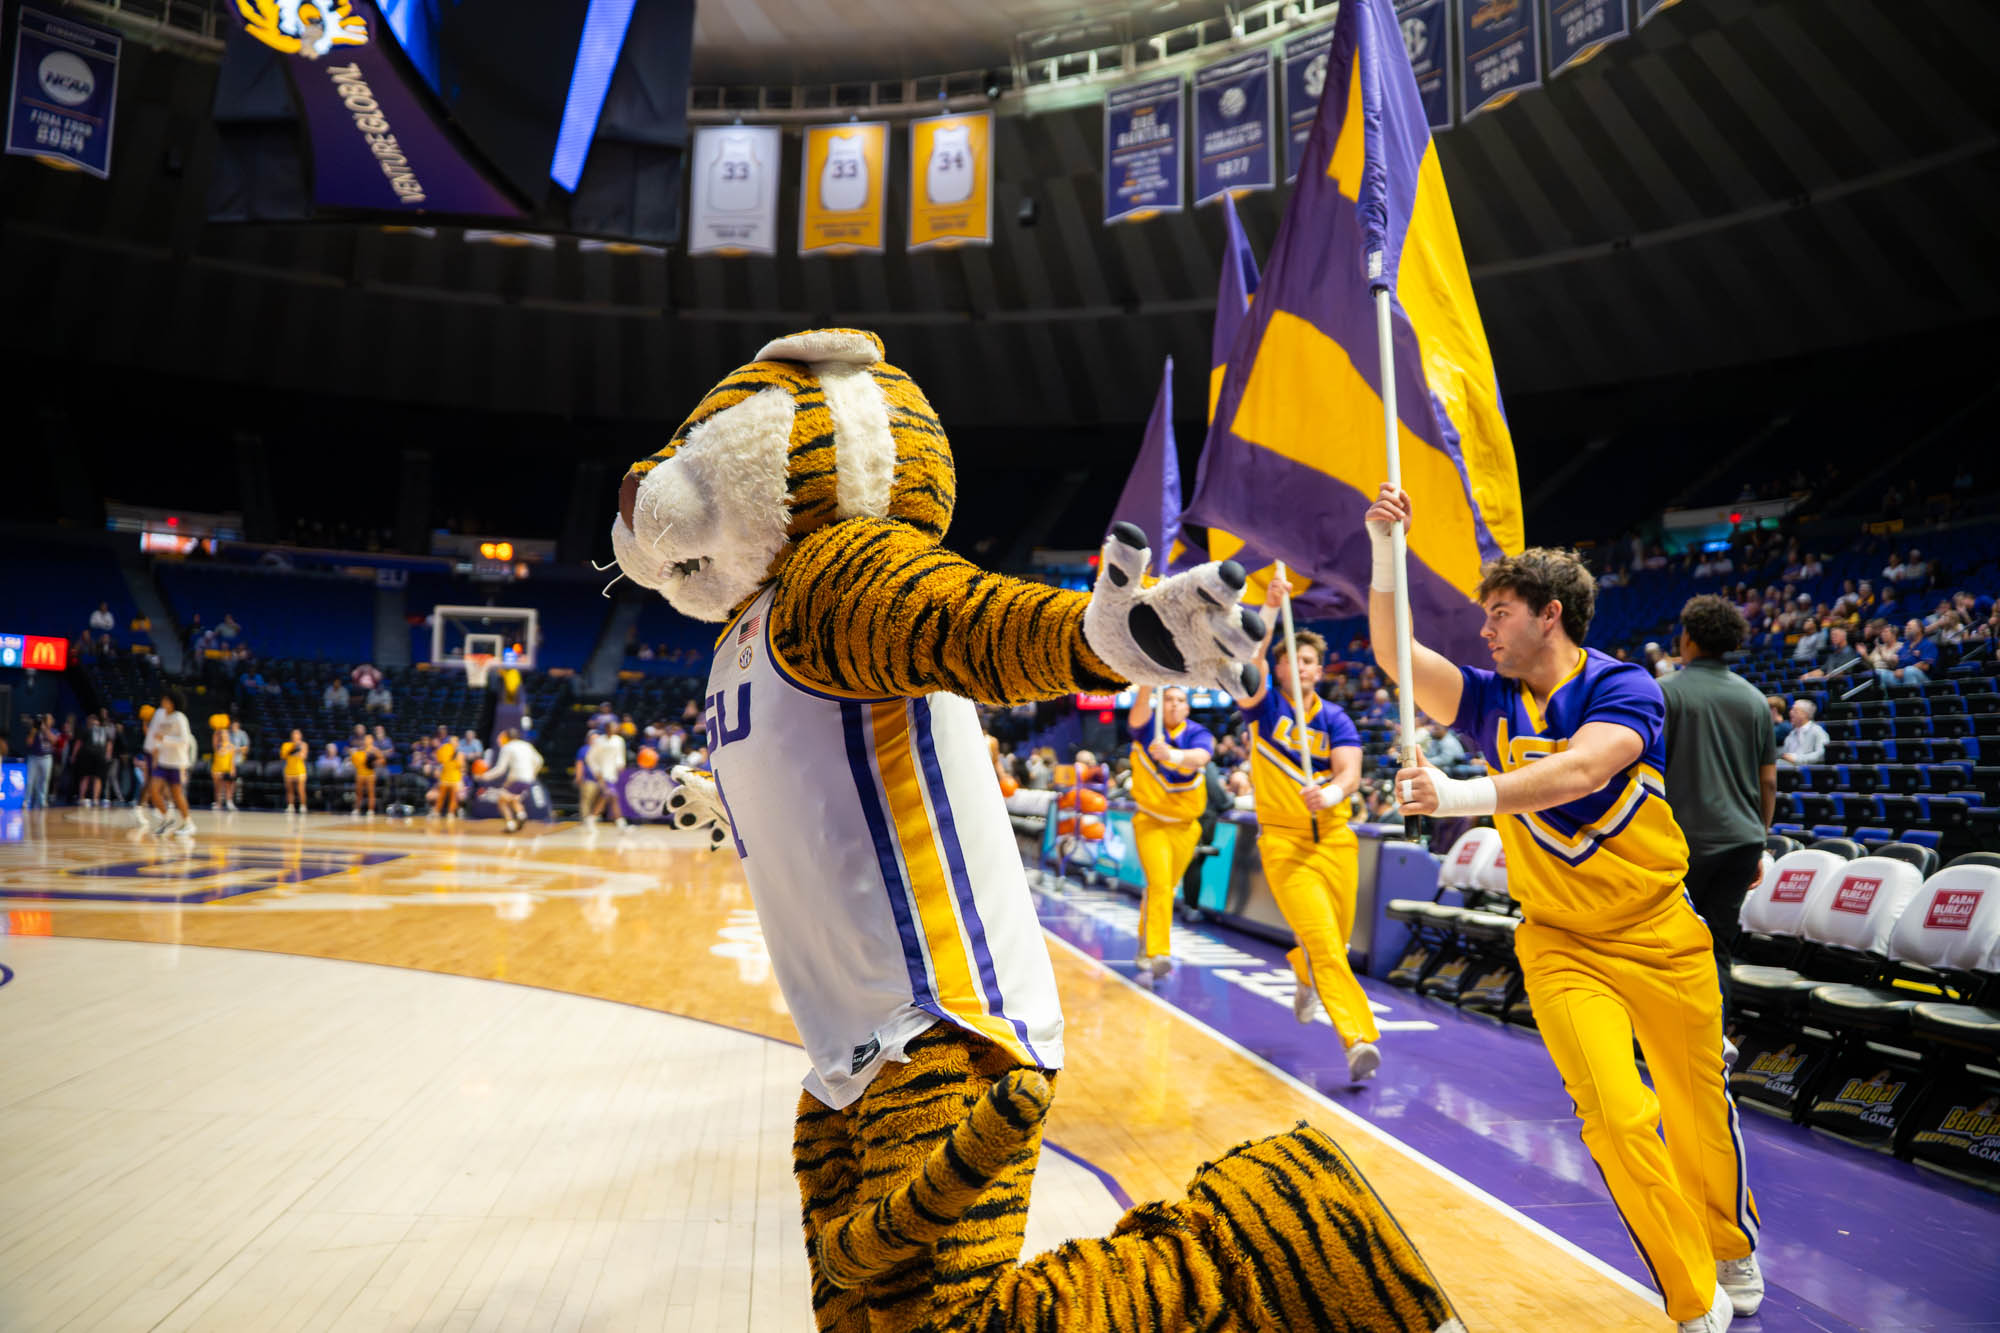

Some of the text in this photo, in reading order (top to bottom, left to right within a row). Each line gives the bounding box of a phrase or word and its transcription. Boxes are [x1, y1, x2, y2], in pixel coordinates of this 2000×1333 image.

[46, 71, 90, 94] NCAA
[326, 62, 426, 204] VENTURE GLOBAL
[720, 161, 749, 181] 33
[831, 160, 859, 179] 33
[938, 151, 964, 172] 34
[1497, 716, 1568, 773] LS
[1790, 873, 1811, 881] FARM
[1853, 881, 1876, 890] FARM
[1841, 888, 1873, 900] BUREAU
[1948, 894, 1976, 905] FARM
[1934, 903, 1973, 914] BUREAU
[1752, 1055, 1803, 1074] Bengal
[1841, 1081, 1901, 1104] Bengal
[1943, 1109, 2000, 1136] Benga
